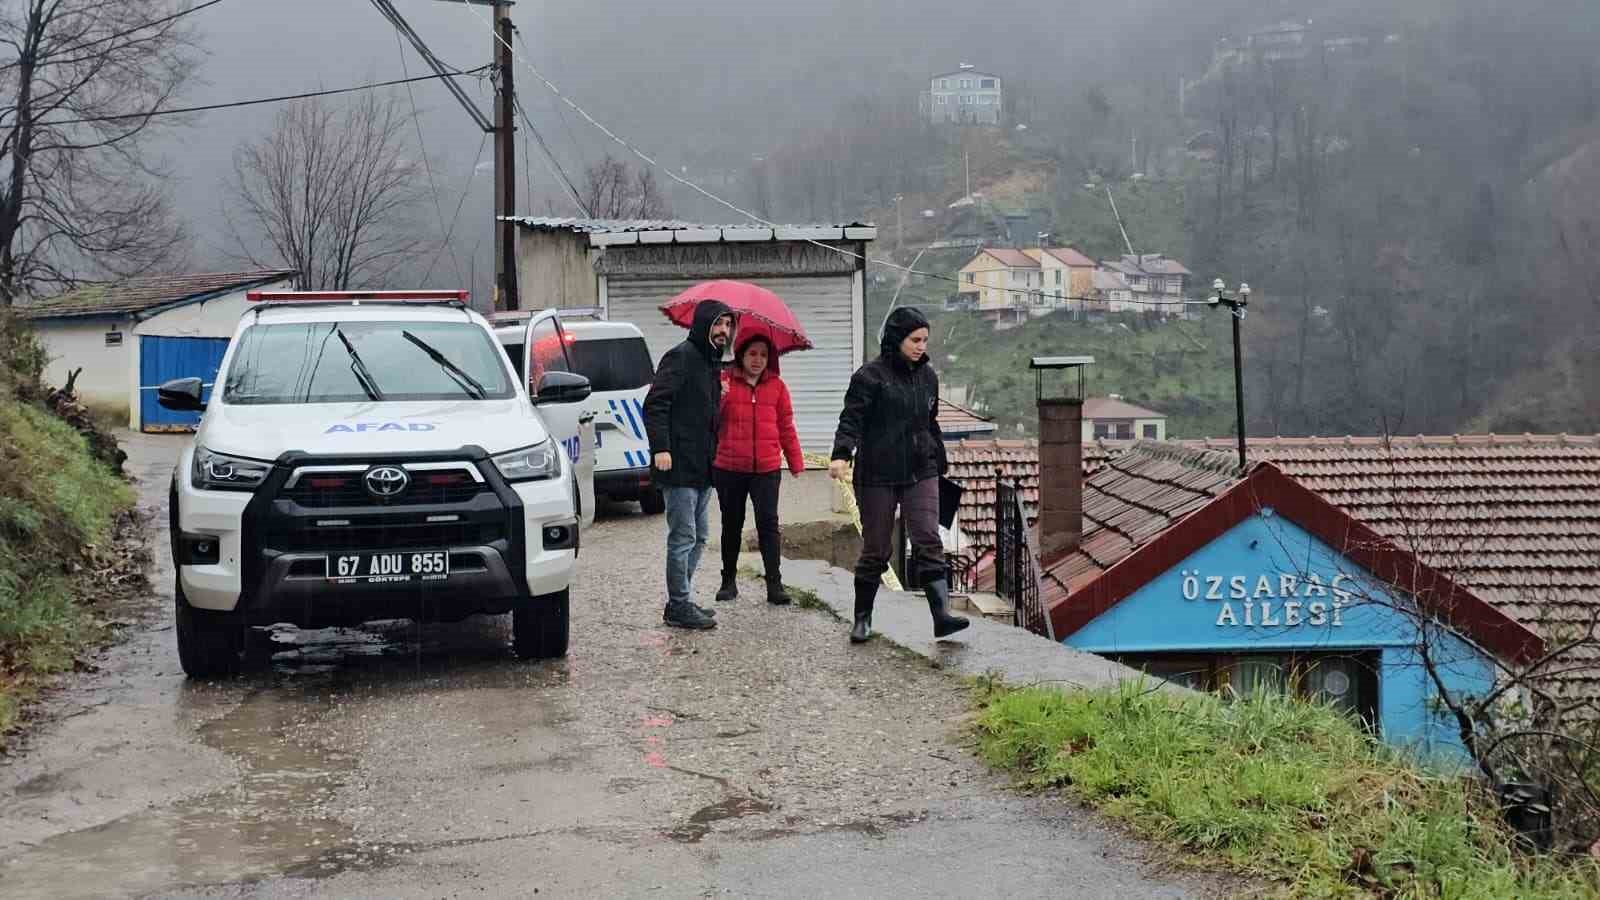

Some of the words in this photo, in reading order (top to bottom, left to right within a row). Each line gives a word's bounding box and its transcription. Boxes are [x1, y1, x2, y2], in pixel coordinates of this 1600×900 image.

[323, 423, 435, 434] AFAD
[338, 556, 360, 576] 67
[369, 554, 402, 575] ADU
[411, 553, 444, 573] 855
[1182, 569, 1353, 603] ÖZSARAÇ
[1216, 597, 1344, 627] AİLESİ
